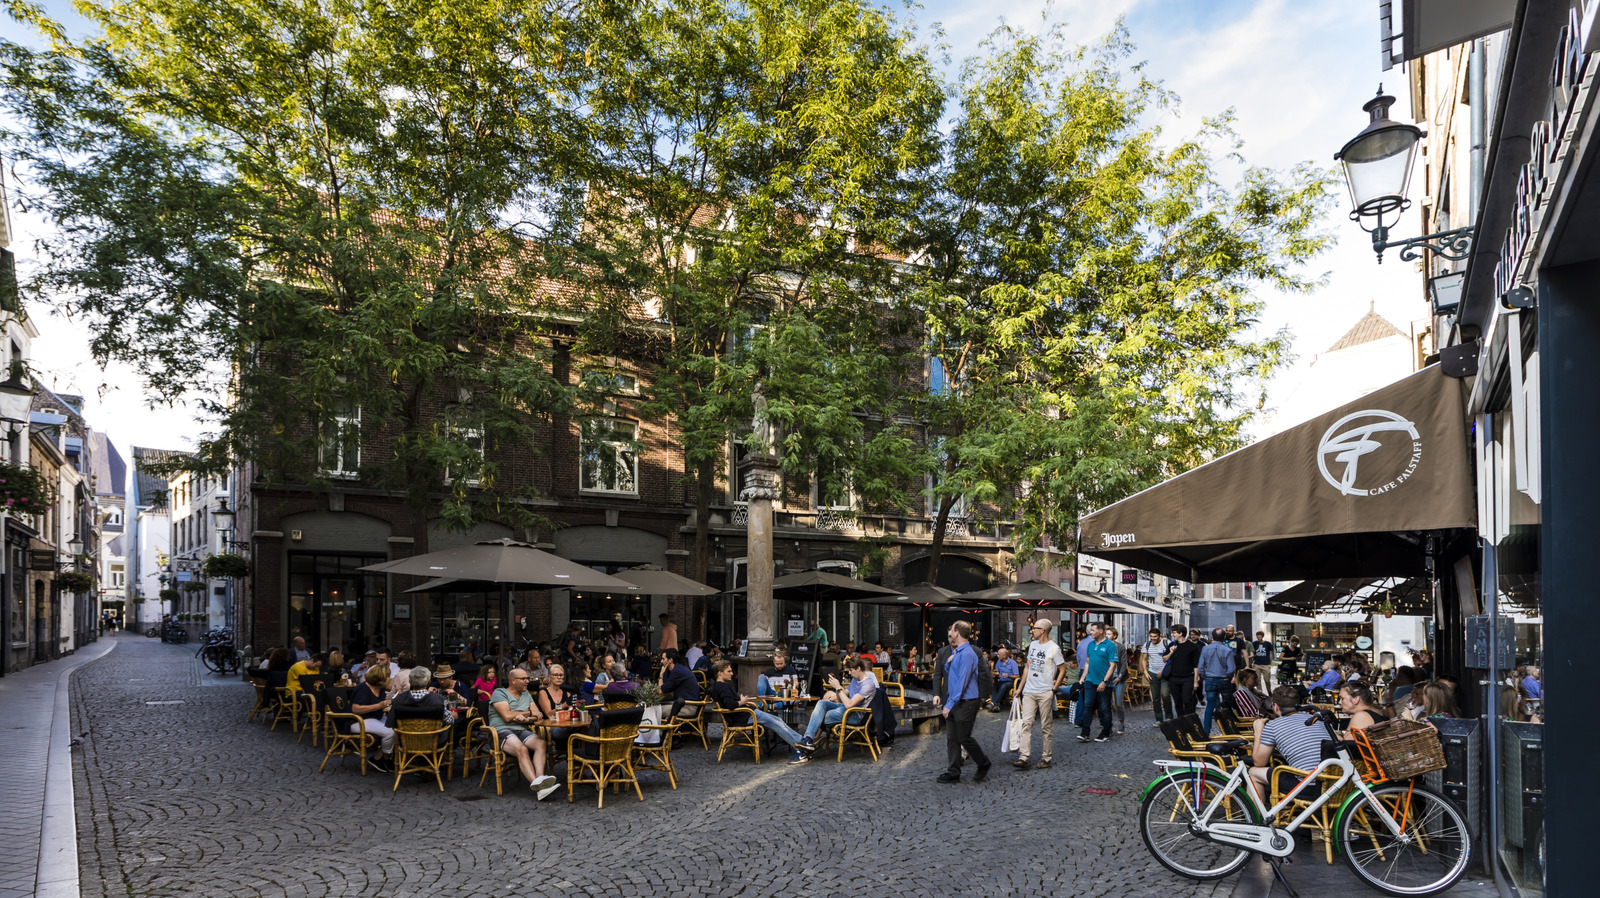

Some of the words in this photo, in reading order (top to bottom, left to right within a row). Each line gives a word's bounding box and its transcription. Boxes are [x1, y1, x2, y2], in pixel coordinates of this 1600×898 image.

[1369, 481, 1398, 496] CAFE
[1396, 441, 1422, 484] FALSTAFF
[1101, 532, 1135, 548] Jopen
